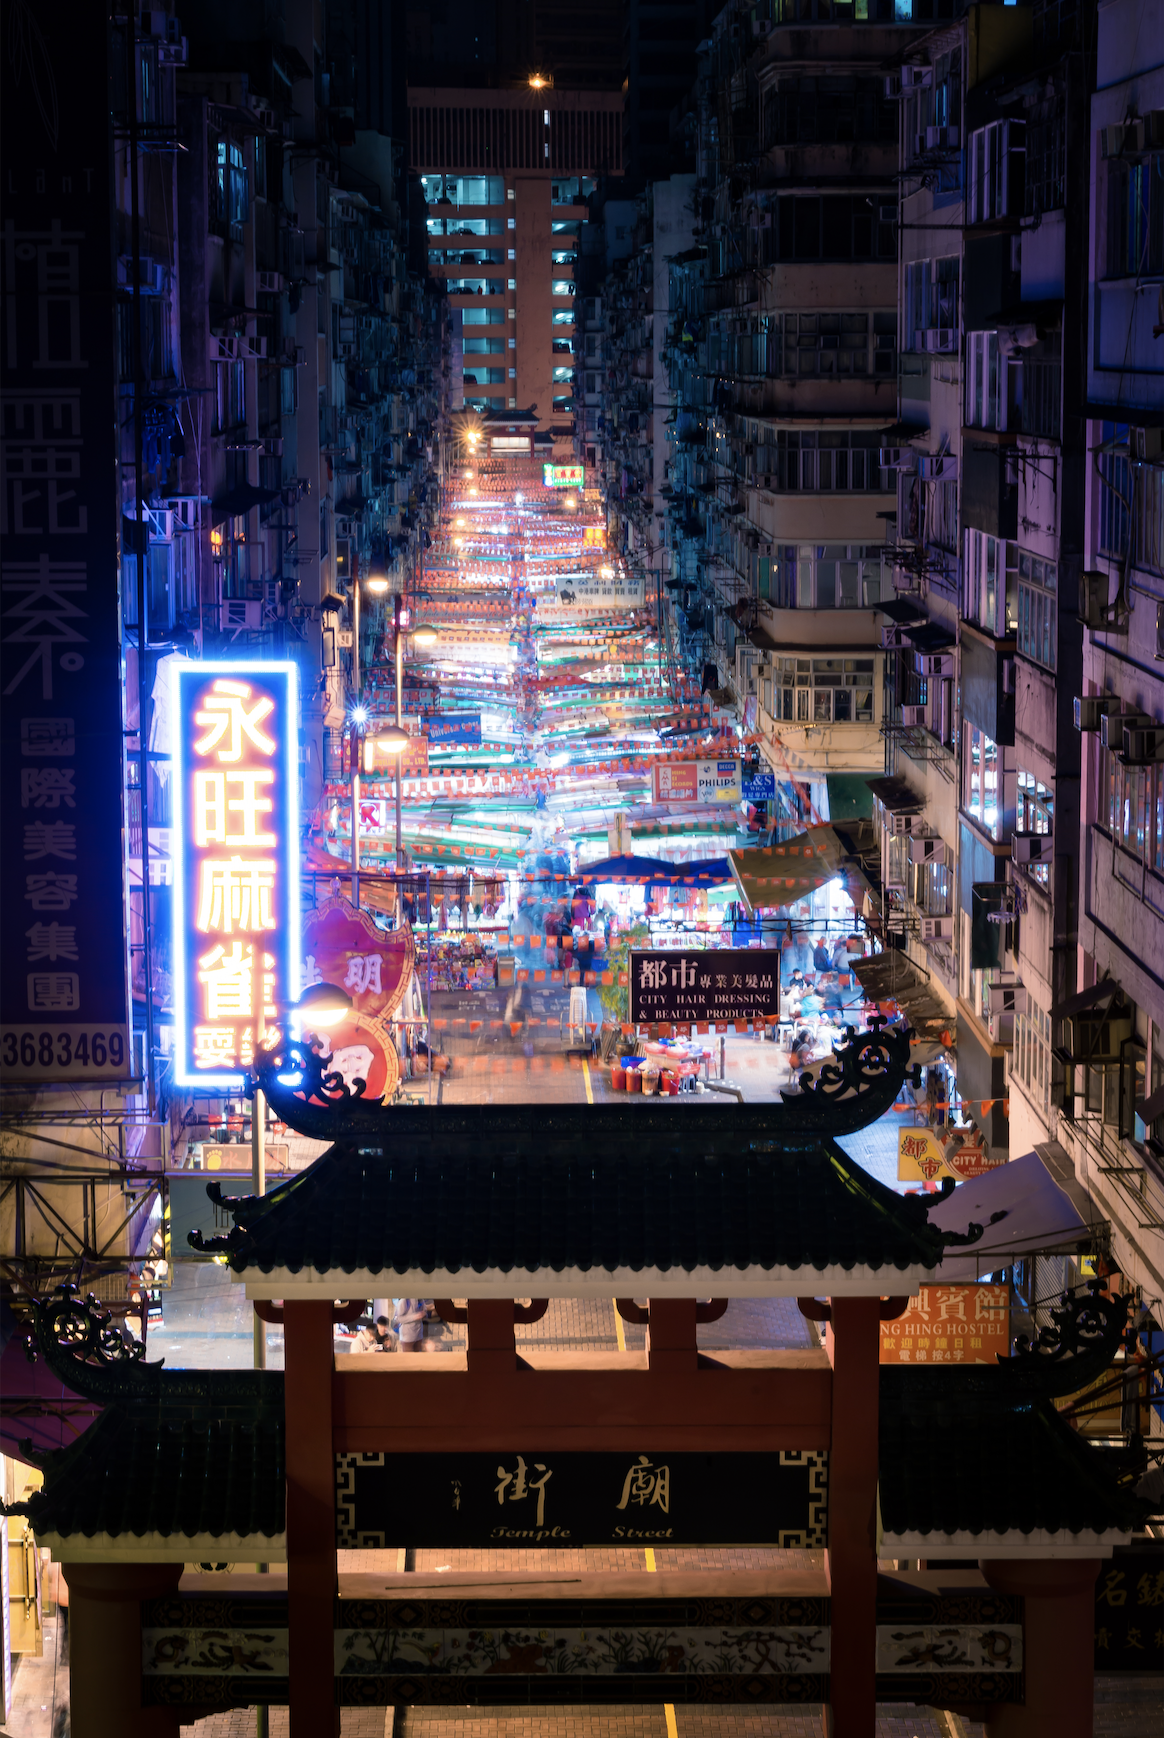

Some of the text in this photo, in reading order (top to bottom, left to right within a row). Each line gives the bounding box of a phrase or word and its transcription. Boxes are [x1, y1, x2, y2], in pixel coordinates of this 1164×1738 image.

[699, 778, 736, 788] PHILIPS
[20, 717, 80, 1011] 國際美容集團
[638, 958, 773, 989] 都市 專業美髮品
[639, 993, 770, 1005] CITY HAIR DRESSING
[639, 1008, 764, 1019] & BEAUTY PRODUCTS
[0, 1031, 124, 1067] 3683469
[901, 1135, 944, 1180] 都市
[953, 1154, 976, 1166] CITY
[883, 1286, 1008, 1322] 興賓館
[904, 1323, 942, 1336] HING
[946, 1323, 1005, 1336] HOSTEL
[883, 1337, 983, 1350] 歡迎時鐘日租
[899, 1349, 965, 1362] 電梯按4字
[490, 1525, 674, 1541] Temple Street
